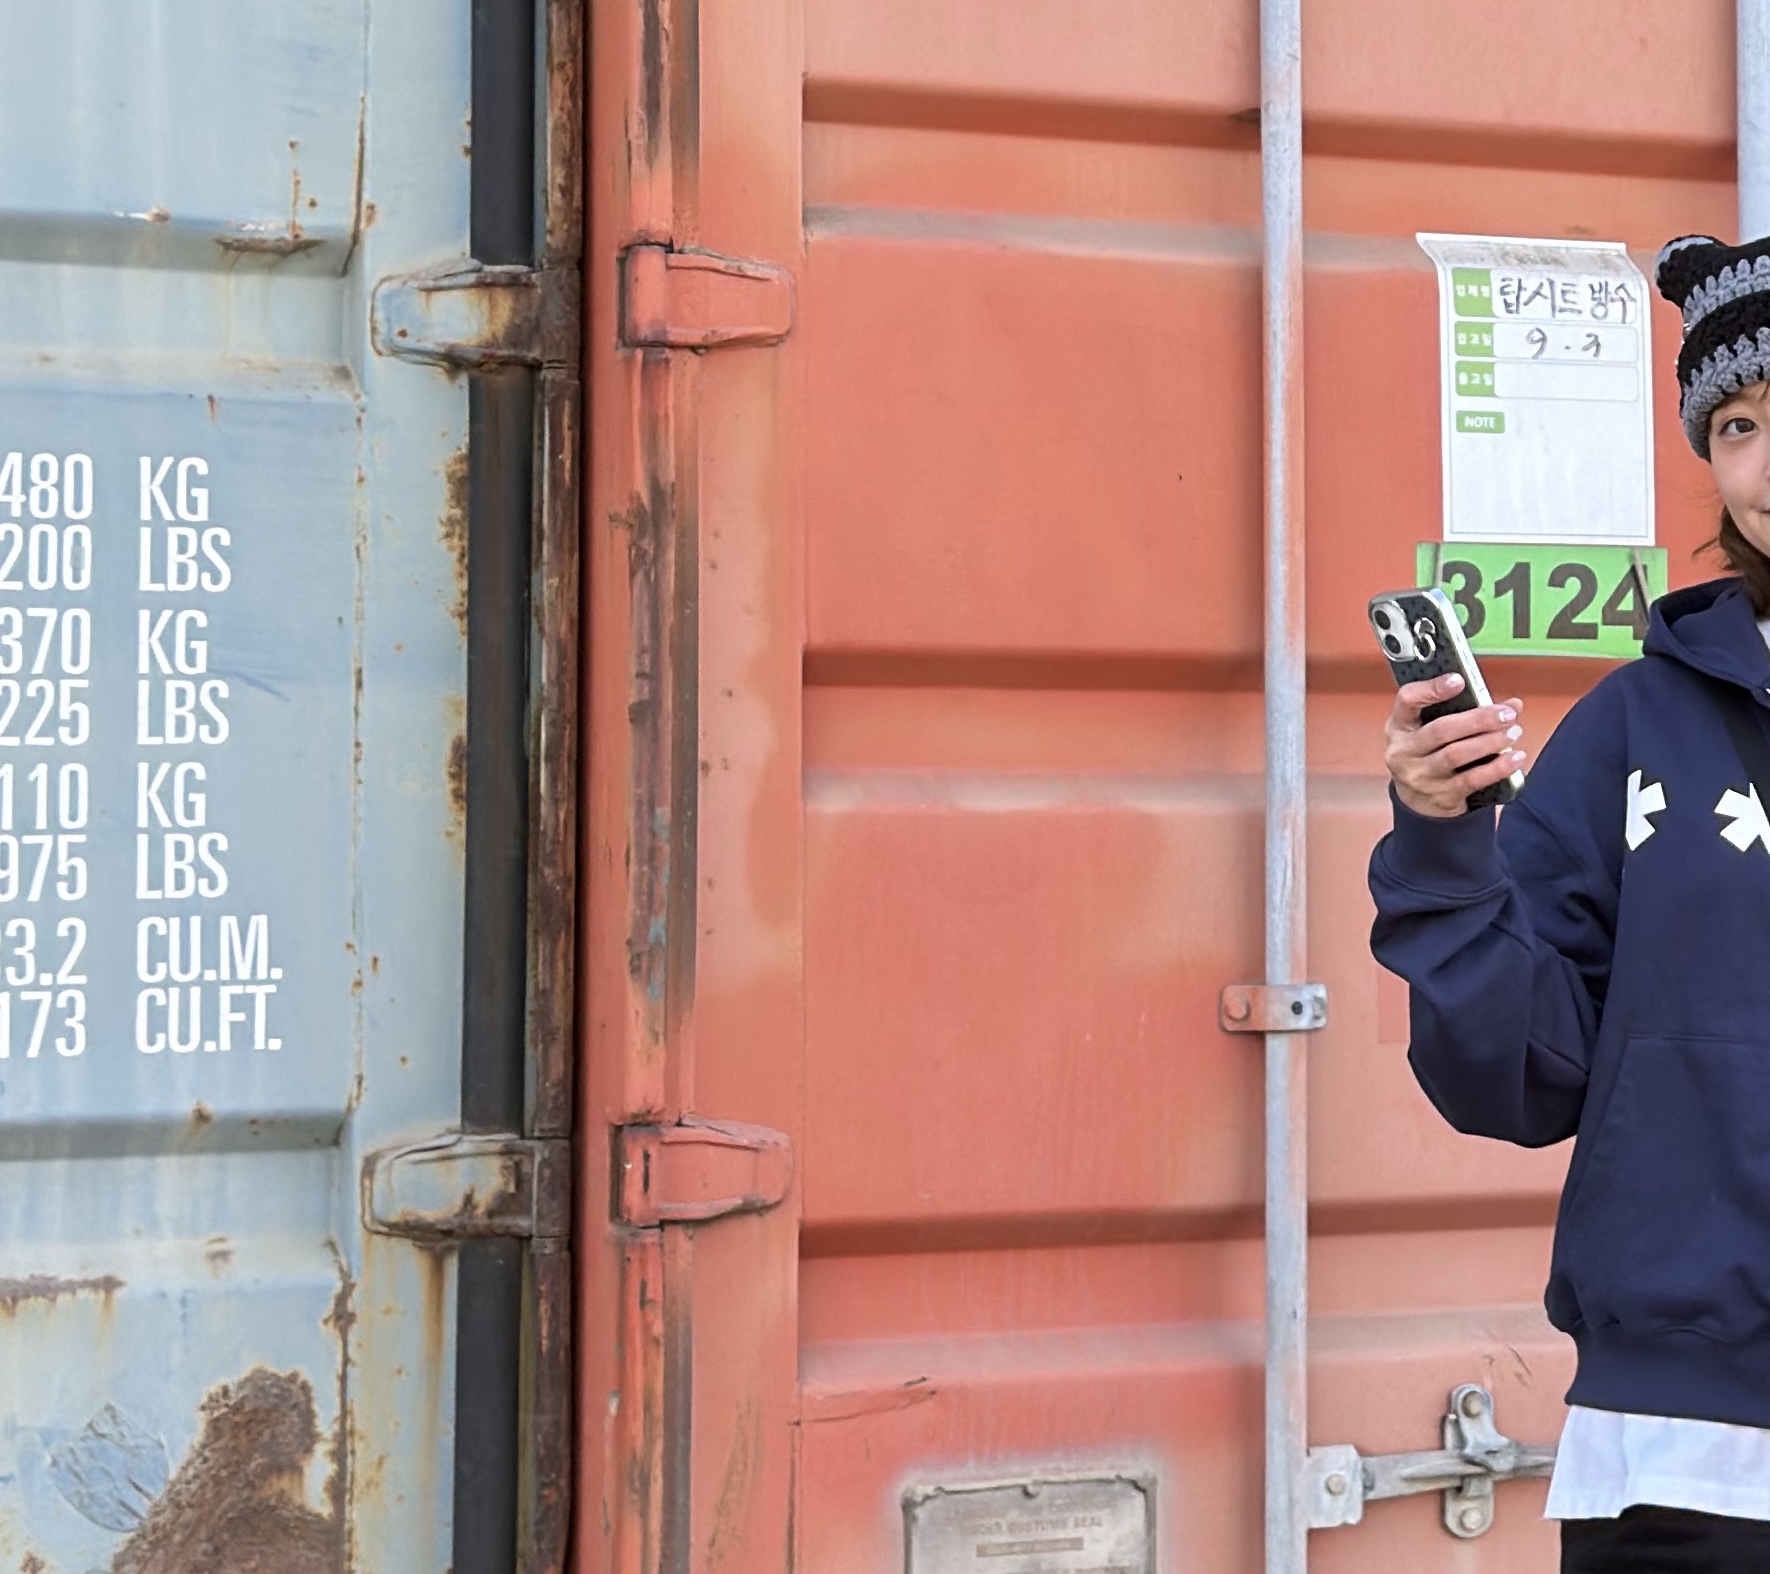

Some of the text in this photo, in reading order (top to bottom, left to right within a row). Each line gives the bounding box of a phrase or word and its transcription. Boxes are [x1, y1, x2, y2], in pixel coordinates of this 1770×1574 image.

[1464, 415, 1496, 429] NOTE
[140, 456, 208, 521] KG
[0, 523, 230, 592] 200 LBS
[1443, 560, 1650, 641] 3124
[0, 607, 207, 674] 370 KG
[0, 679, 229, 746] 225 LBS
[138, 762, 206, 827] KG
[137, 833, 228, 899] LBS
[0, 915, 282, 986] 3.2 CU.M.
[136, 985, 281, 1053] CU.FT.
